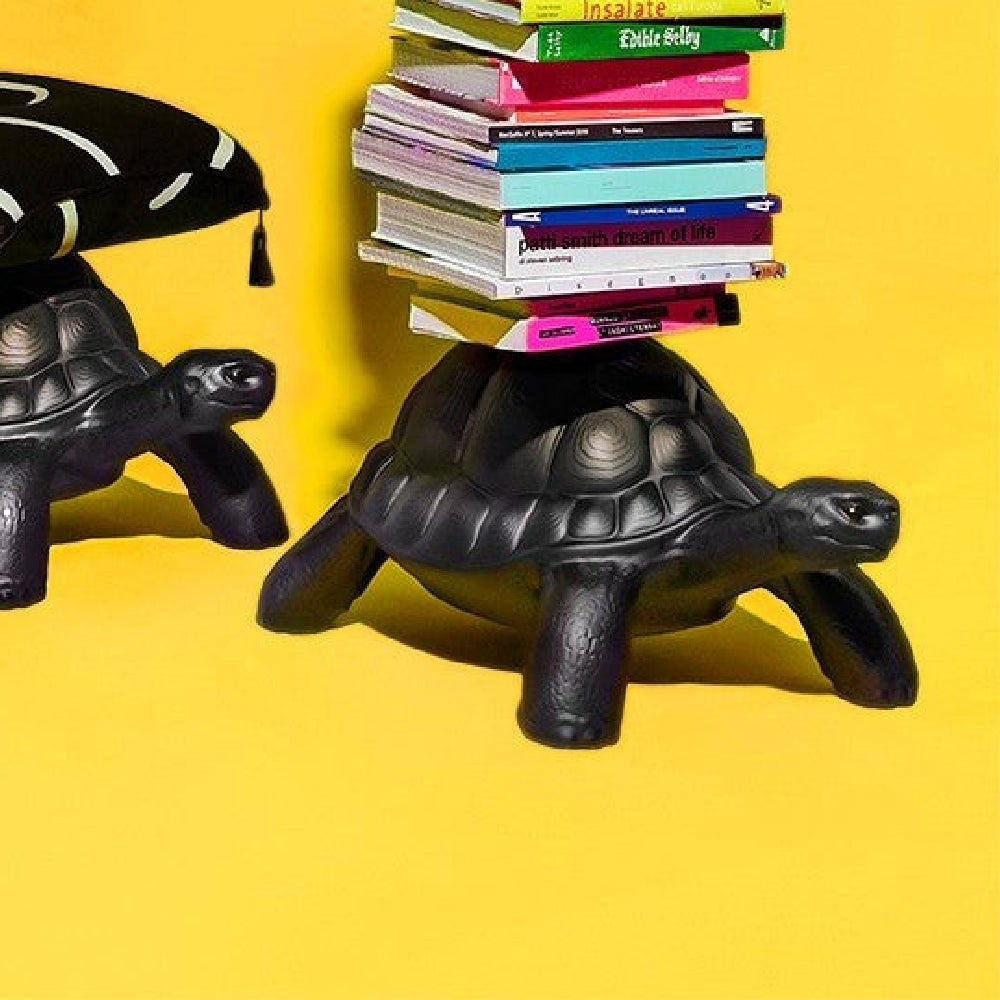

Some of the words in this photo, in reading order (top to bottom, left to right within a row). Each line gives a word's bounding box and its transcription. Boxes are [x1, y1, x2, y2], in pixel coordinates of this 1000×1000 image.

[618, 28, 661, 49] Edible
[662, 24, 701, 50] Selby
[518, 232, 556, 256] patti
[562, 230, 609, 250] smith
[612, 227, 664, 246] dream
[670, 224, 687, 241] of
[690, 222, 717, 240] life
